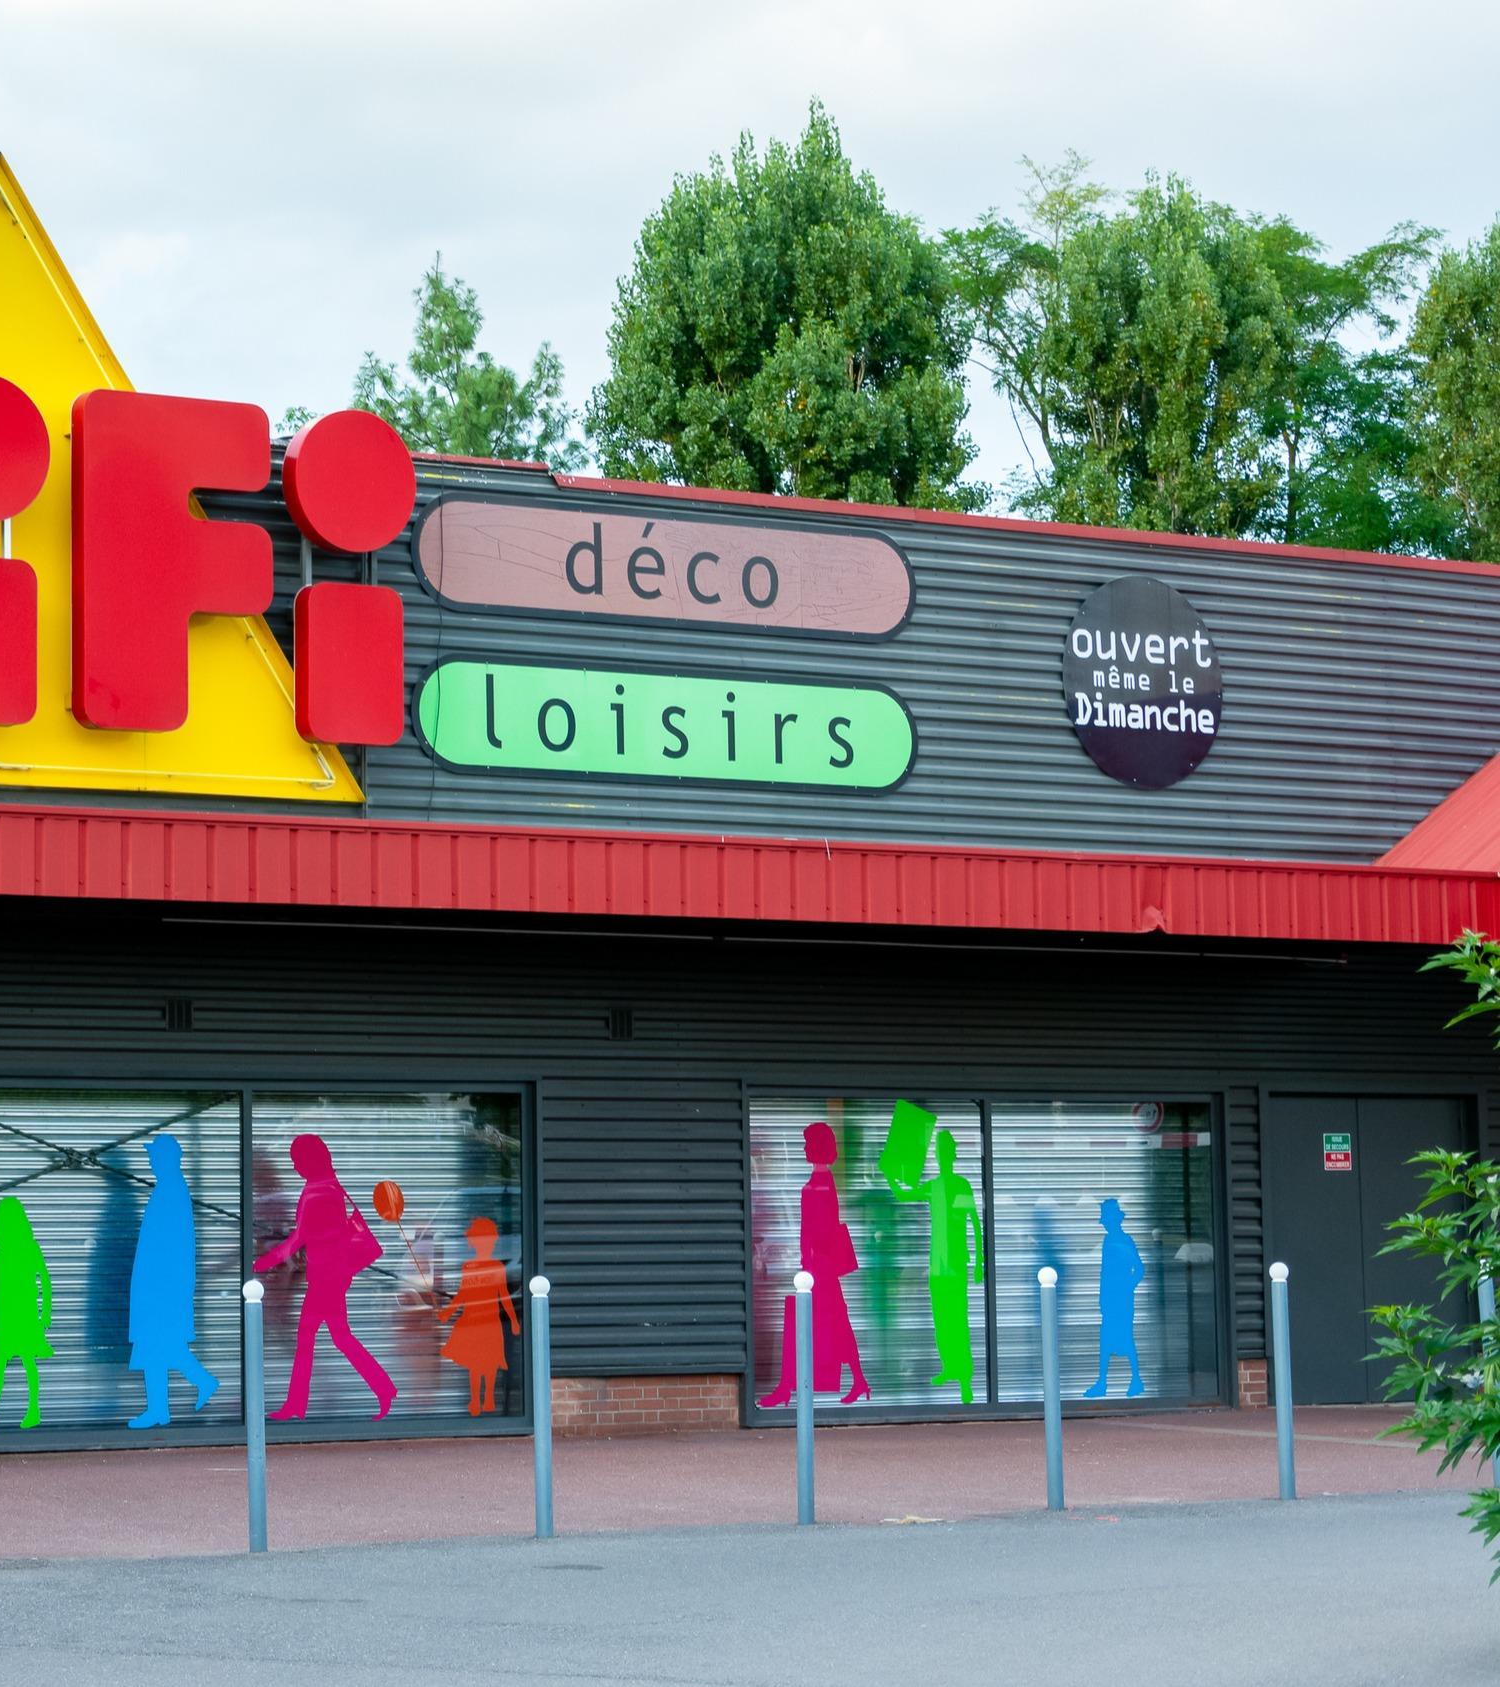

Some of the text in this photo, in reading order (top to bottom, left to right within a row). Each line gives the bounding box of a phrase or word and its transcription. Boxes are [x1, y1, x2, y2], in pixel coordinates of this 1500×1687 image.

[566, 522, 779, 608] déco
[1072, 628, 1211, 668] ouvert
[1093, 665, 1194, 694] même le
[486, 673, 855, 768] loisirs
[1074, 692, 1215, 734] Dimanche
